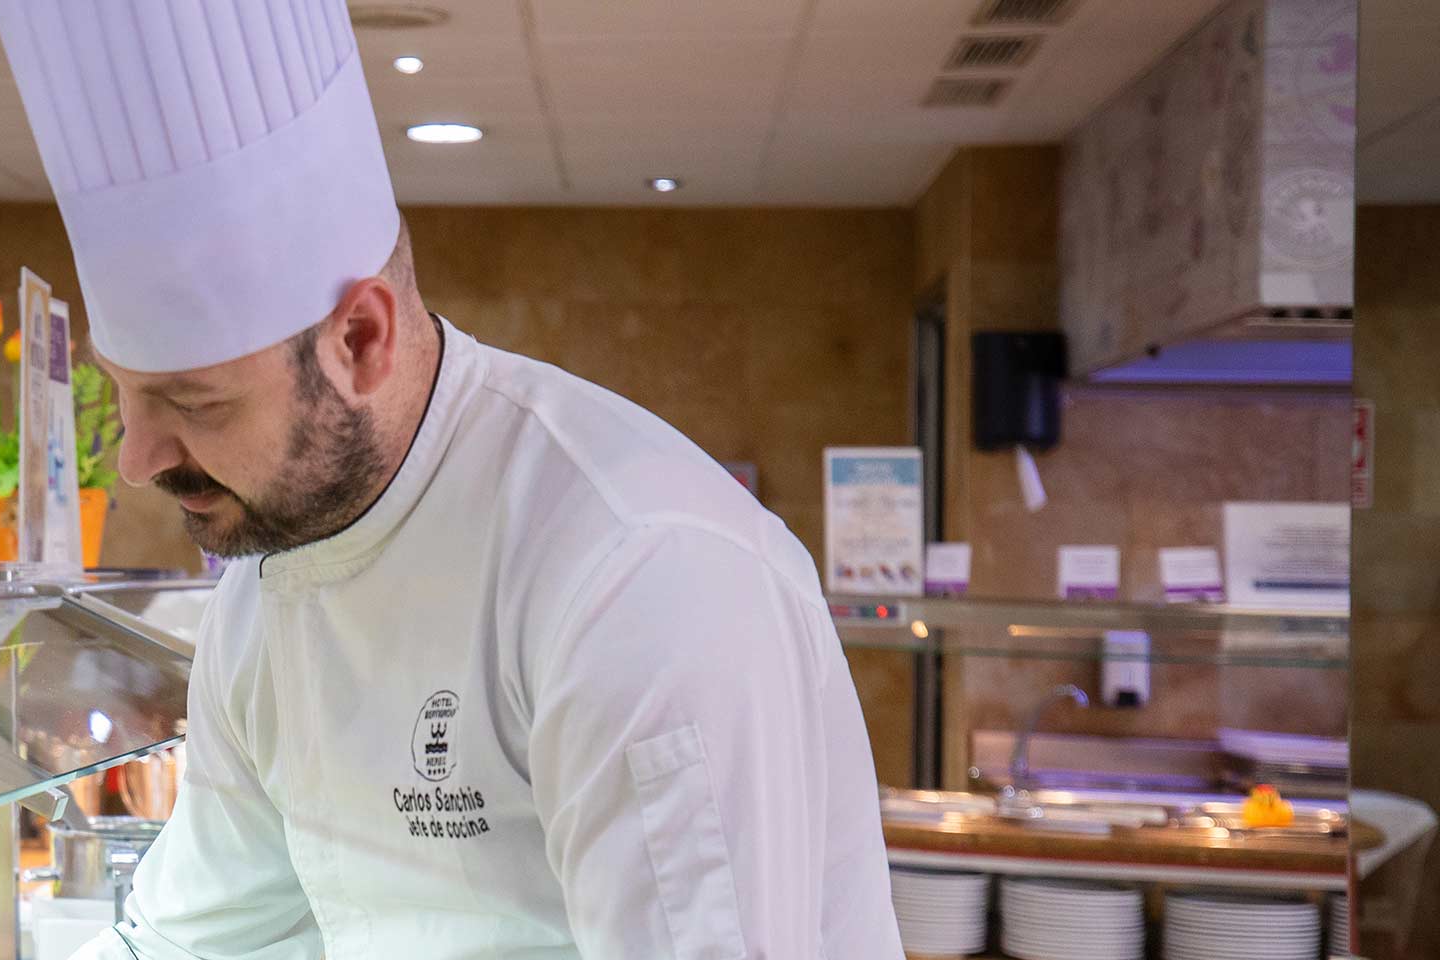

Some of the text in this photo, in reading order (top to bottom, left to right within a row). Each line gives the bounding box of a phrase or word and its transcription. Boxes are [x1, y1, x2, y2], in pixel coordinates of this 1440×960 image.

[431, 698, 453, 708] HOTEL
[393, 786, 485, 812] Carlos Sanchis
[430, 815, 444, 838] de
[446, 815, 490, 838] cocina
